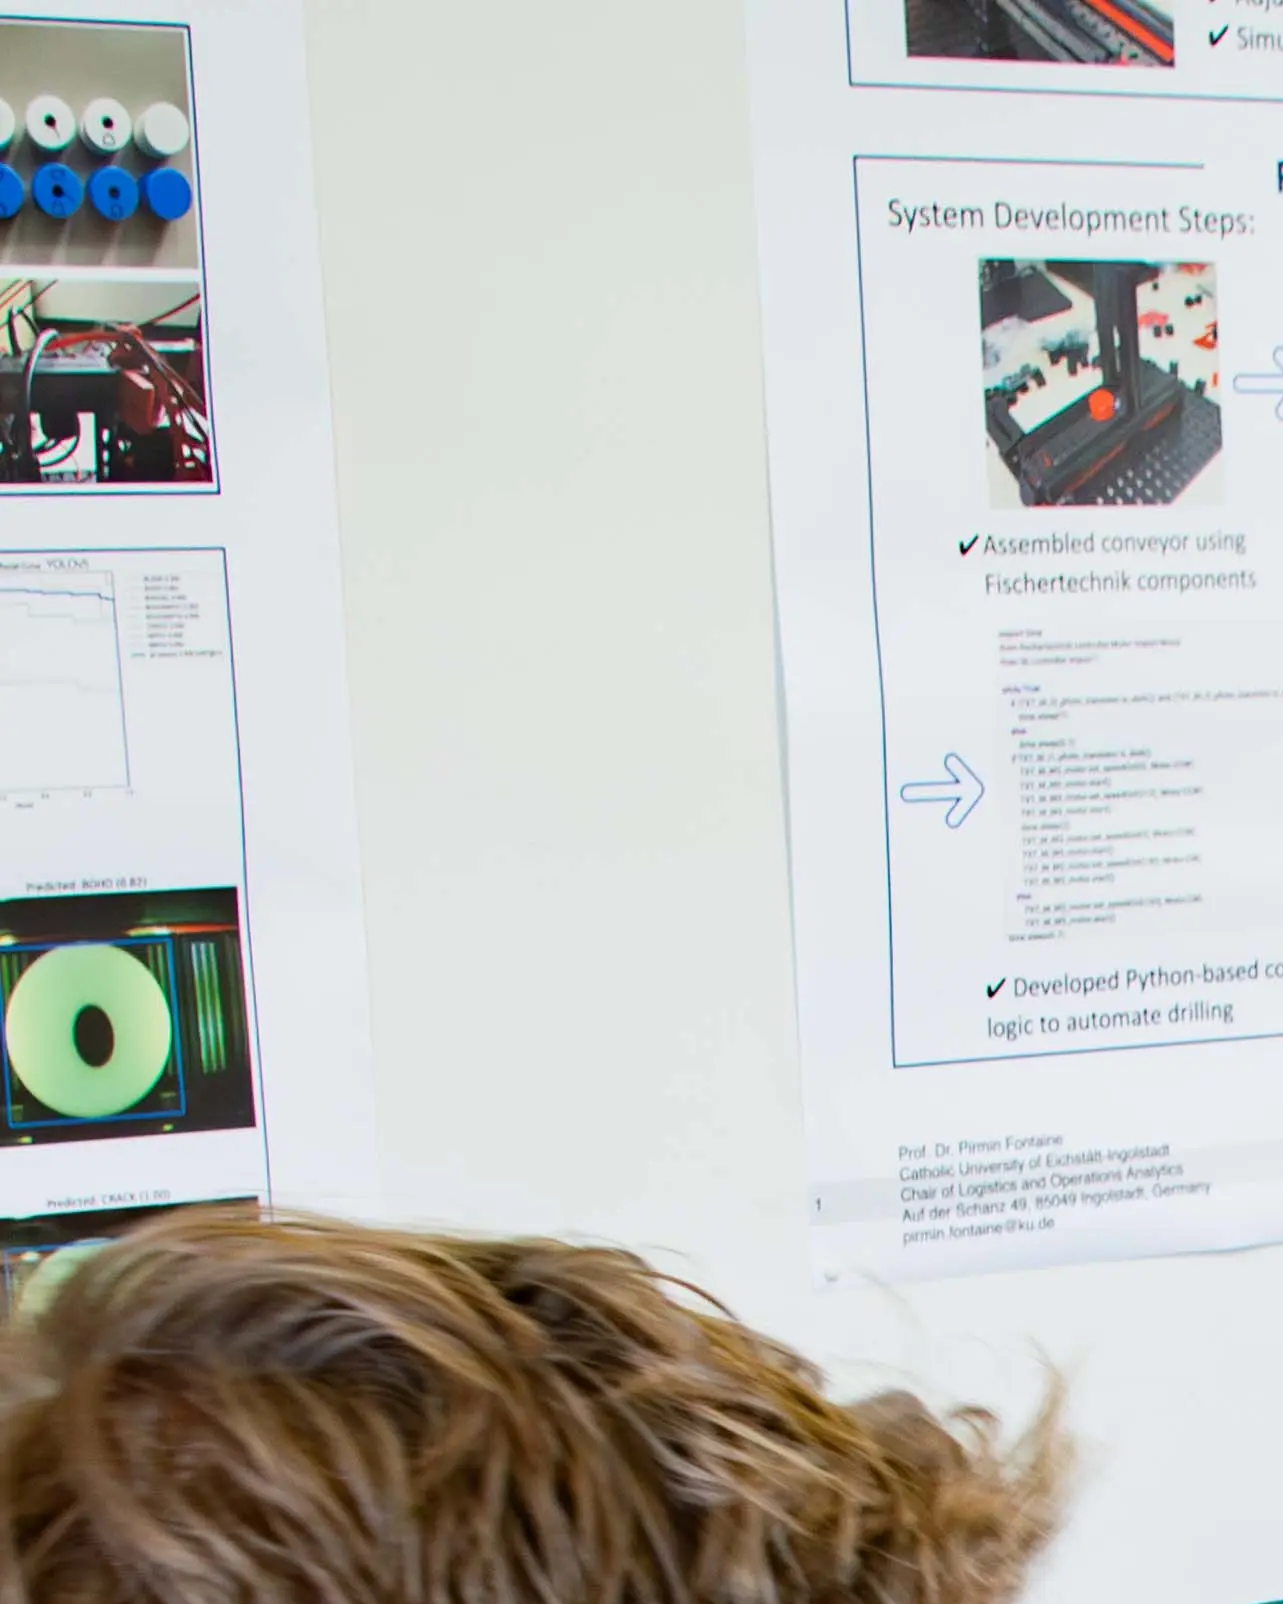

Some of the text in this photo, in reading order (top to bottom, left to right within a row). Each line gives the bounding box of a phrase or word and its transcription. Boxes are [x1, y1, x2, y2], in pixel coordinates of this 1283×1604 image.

[888, 199, 1257, 240] System Development Steps:
[984, 532, 1247, 556] Assembled conveyor using
[985, 569, 1257, 595] Fischertechnik components
[1013, 971, 1121, 1002] Developed
[1126, 961, 1260, 993] Python-based
[987, 1000, 1235, 1041] logic to automate drilling
[957, 1140, 1002, 1157] Pirmin
[1004, 1134, 1064, 1151] Fontaine
[899, 1165, 955, 1184] Catholic
[958, 1159, 1026, 1180] University
[1028, 1157, 1042, 1170] of
[900, 1164, 1185, 1203] Chair of Logistics and Operations Analytics
[901, 1207, 927, 1223] Auf
[928, 1205, 952, 1221] der
[1151, 1180, 1212, 1203] Germany
